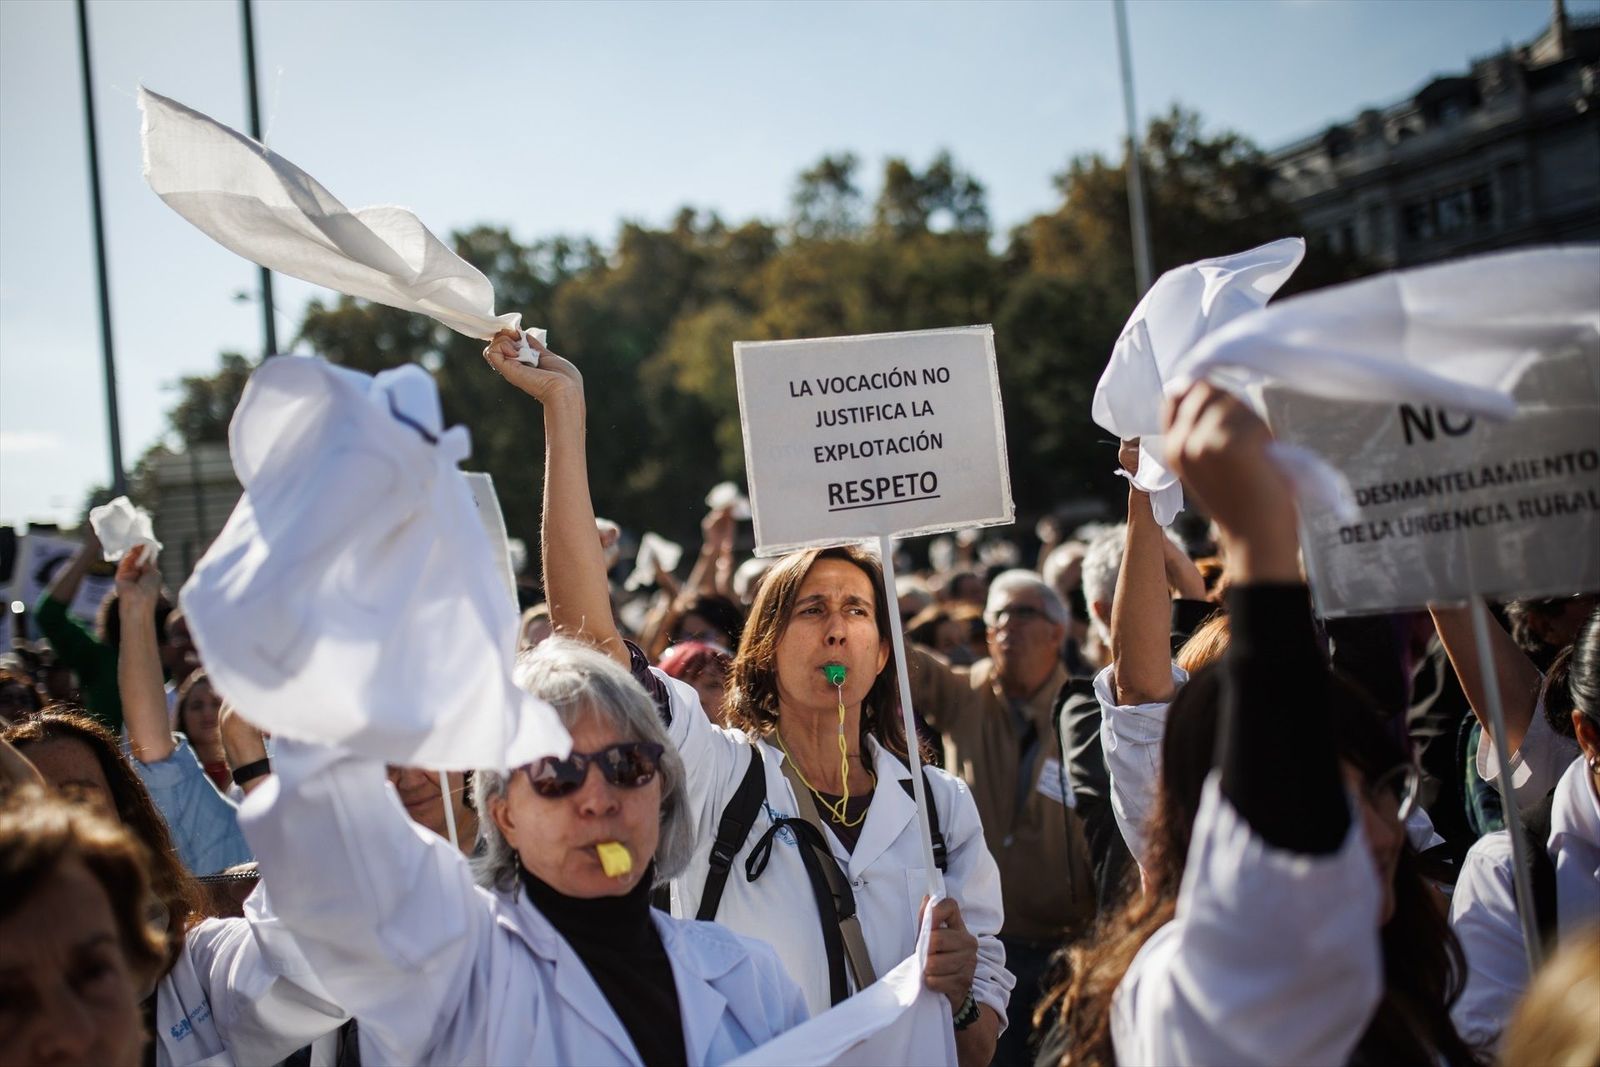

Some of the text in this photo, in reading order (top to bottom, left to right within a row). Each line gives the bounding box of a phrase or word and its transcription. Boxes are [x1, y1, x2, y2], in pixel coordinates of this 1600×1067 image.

[789, 367, 950, 398] LA VOCACIÓN NO
[816, 400, 934, 428] JUSTIFICA LA
[1399, 403, 1474, 446] NO
[813, 430, 943, 463] EXPLOTACIÓN
[828, 471, 938, 506] RESPETO
[1356, 449, 1599, 507] DESMANTELAMIENTO
[1339, 490, 1600, 545] DE LA URGENCIA RURAL
